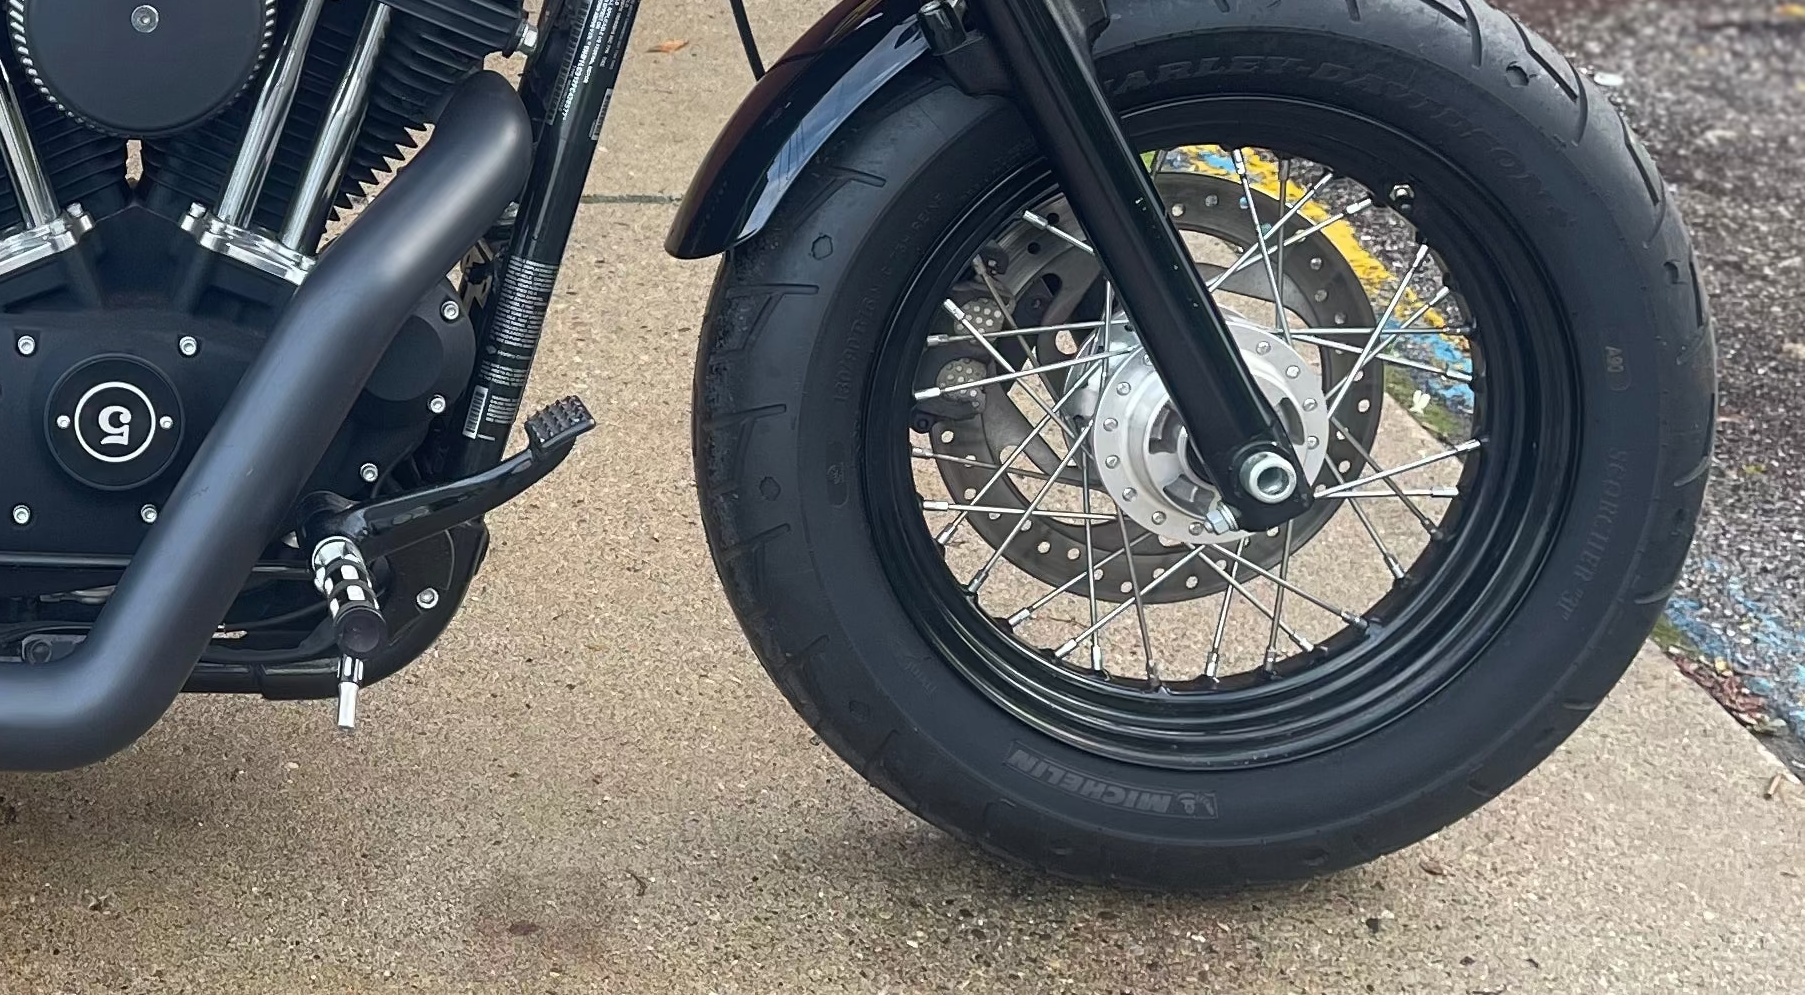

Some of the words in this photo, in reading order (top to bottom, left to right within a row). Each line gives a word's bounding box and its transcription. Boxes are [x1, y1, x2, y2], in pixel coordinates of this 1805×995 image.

[1102, 53, 1544, 199] ARLEY-DAVIDSON
[97, 405, 133, 446] 5
[1572, 446, 1629, 583] SCORCHER
[1009, 749, 1173, 814] MICHELIN
